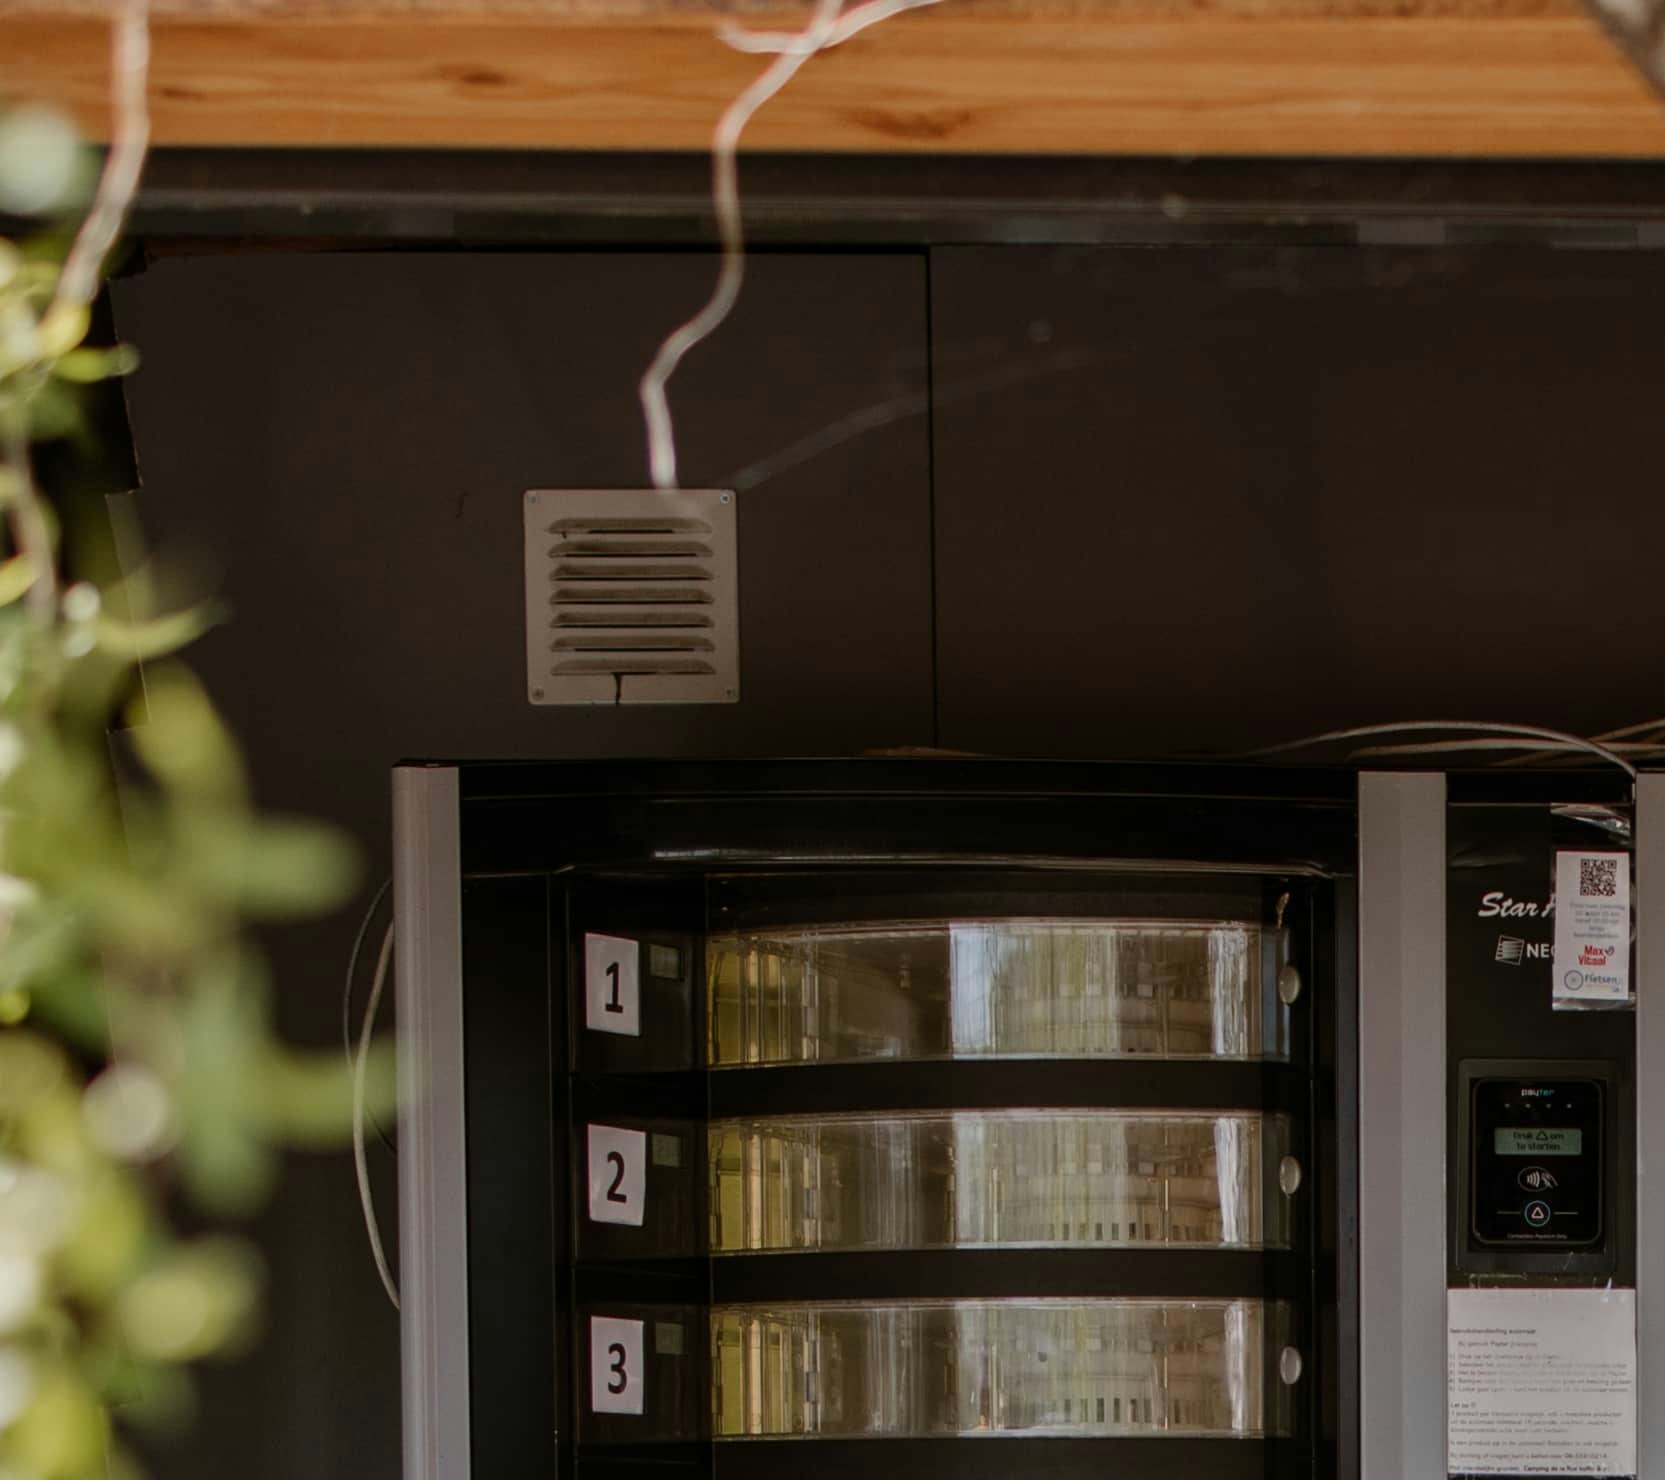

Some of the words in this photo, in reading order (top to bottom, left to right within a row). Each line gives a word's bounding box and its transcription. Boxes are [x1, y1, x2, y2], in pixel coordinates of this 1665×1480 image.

[1478, 892, 1538, 918] Star
[1526, 943, 1554, 958] NE
[1578, 955, 1606, 966] Vitaal
[1584, 945, 1603, 956] Max
[603, 959, 625, 1016] 1
[1521, 1088, 1555, 1097] payter
[605, 1149, 629, 1205] 2
[606, 1341, 629, 1396] 3
